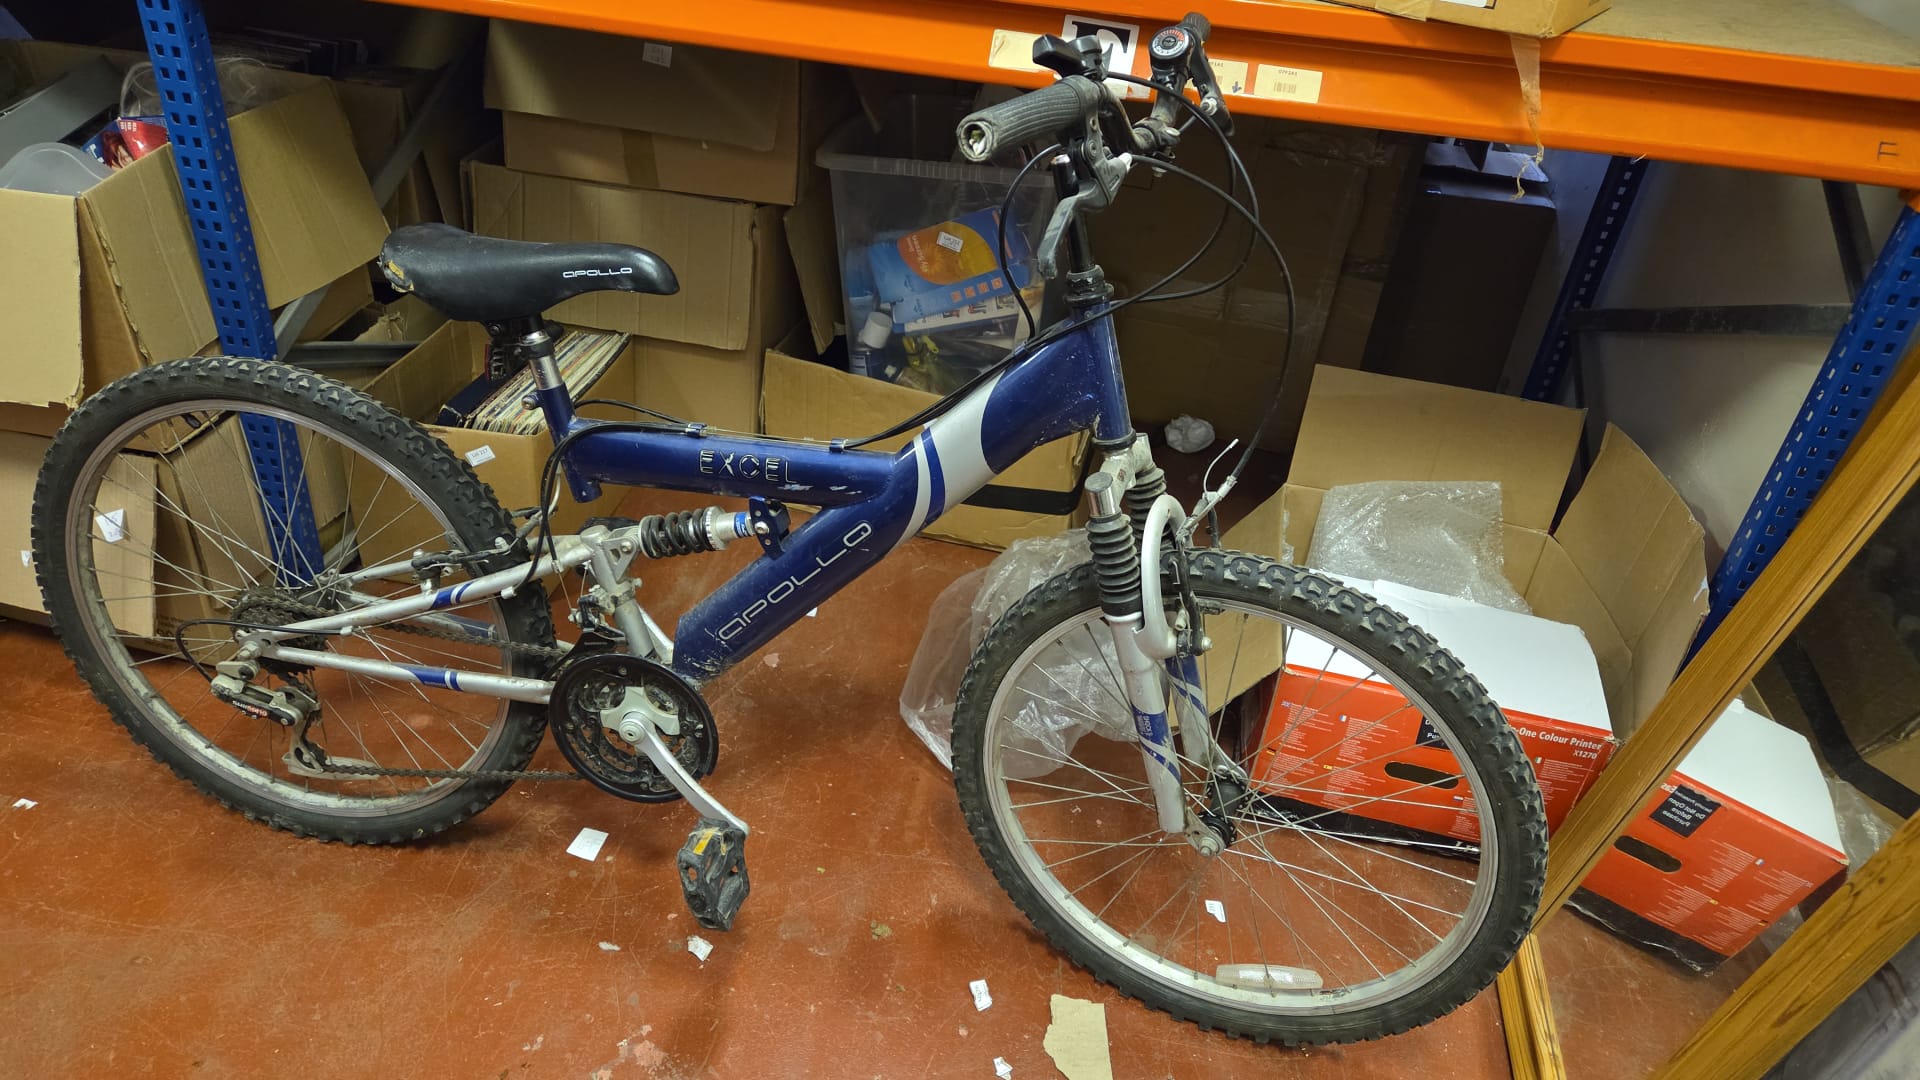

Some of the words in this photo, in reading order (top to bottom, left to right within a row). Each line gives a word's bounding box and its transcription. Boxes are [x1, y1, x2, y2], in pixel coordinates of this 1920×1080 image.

[562, 267, 633, 278] APOLLO
[699, 449, 797, 484] EXCEL
[718, 520, 872, 640] APOLLO
[1539, 731, 1568, 745] Colour
[1570, 737, 1602, 750] Printer
[1573, 749, 1598, 760] X1270
